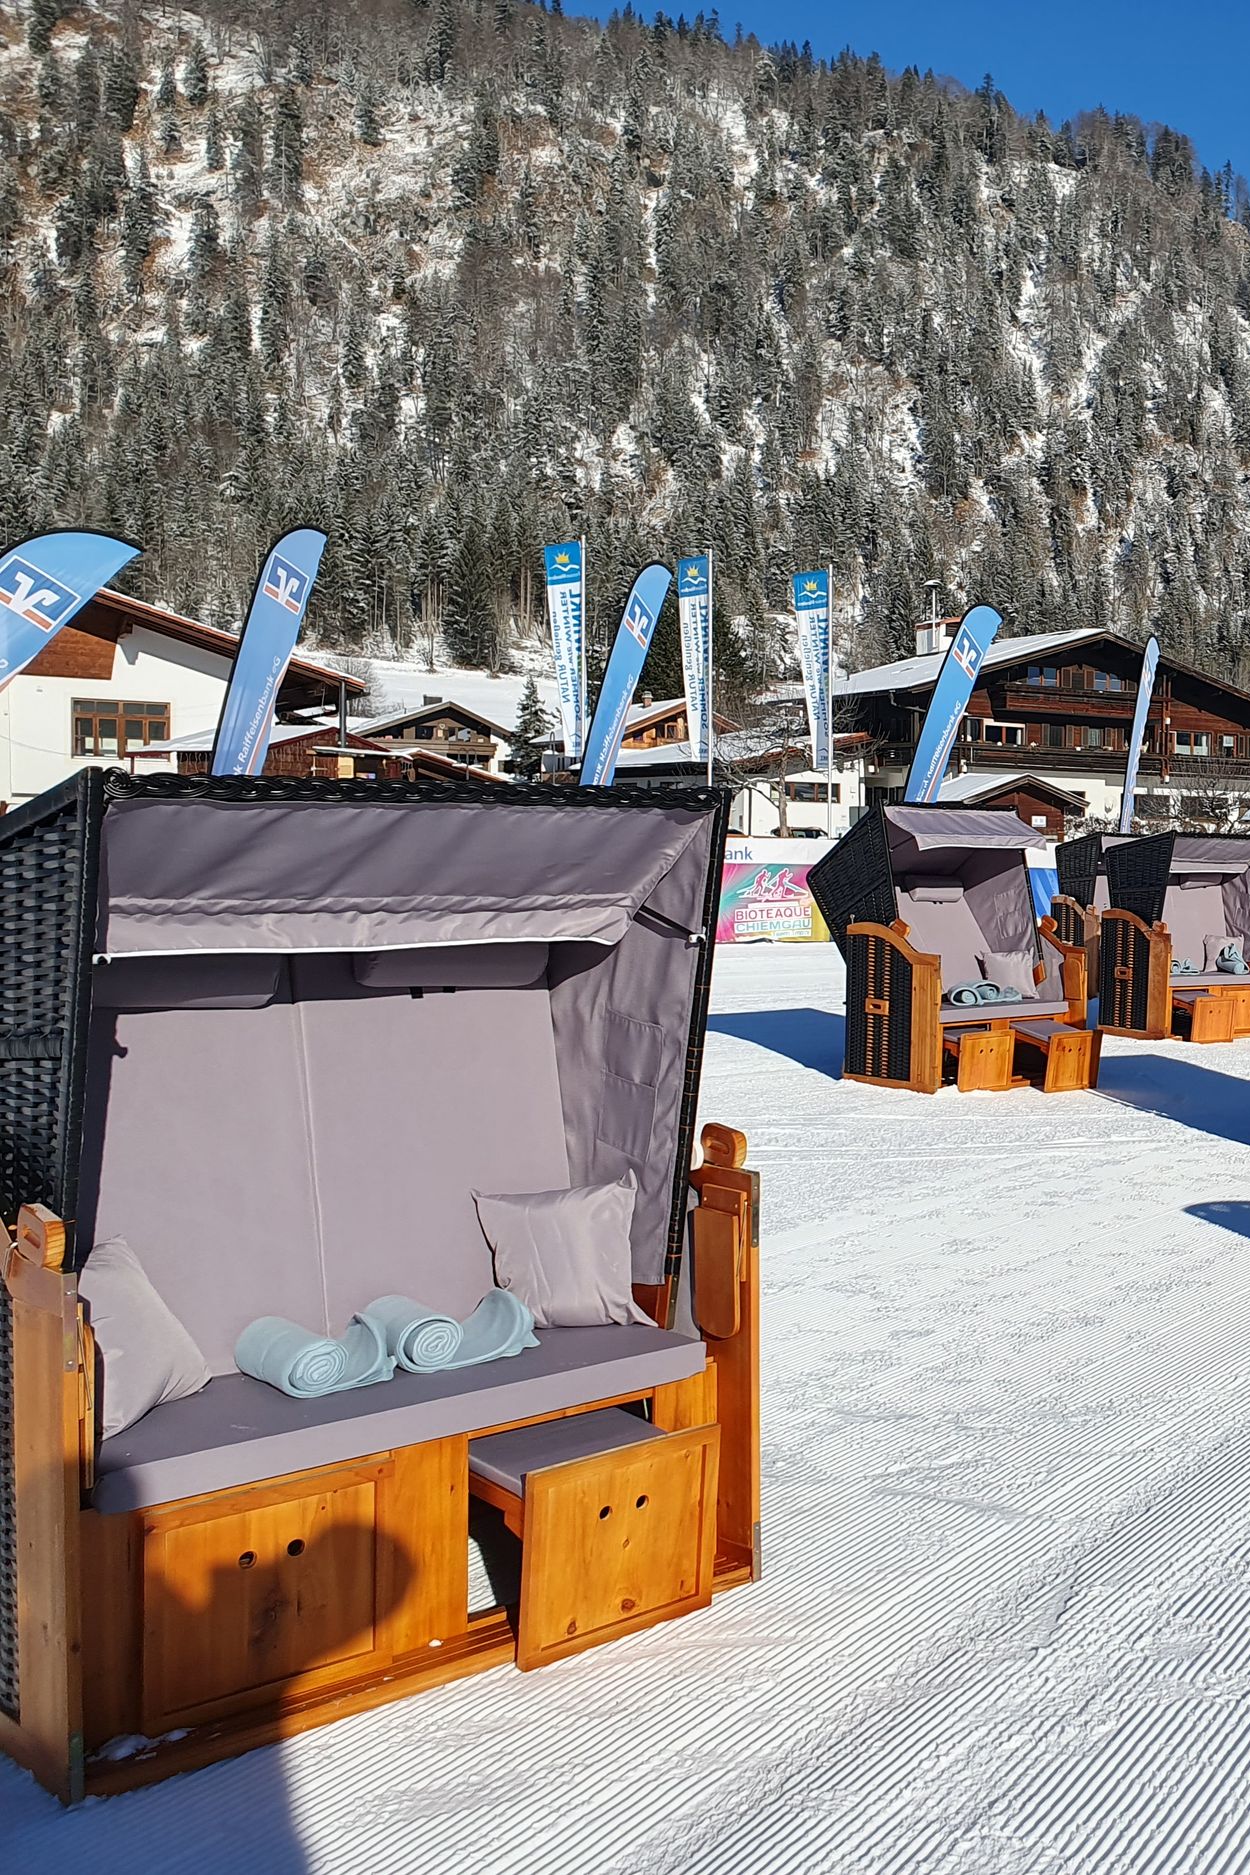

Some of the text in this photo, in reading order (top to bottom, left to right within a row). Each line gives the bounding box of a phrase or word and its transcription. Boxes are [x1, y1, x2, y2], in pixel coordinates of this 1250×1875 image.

[237, 674, 275, 763] Raiffeisenbank
[736, 906, 811, 921] BIOTEAQUE
[736, 919, 811, 932] CHIEMGAU
